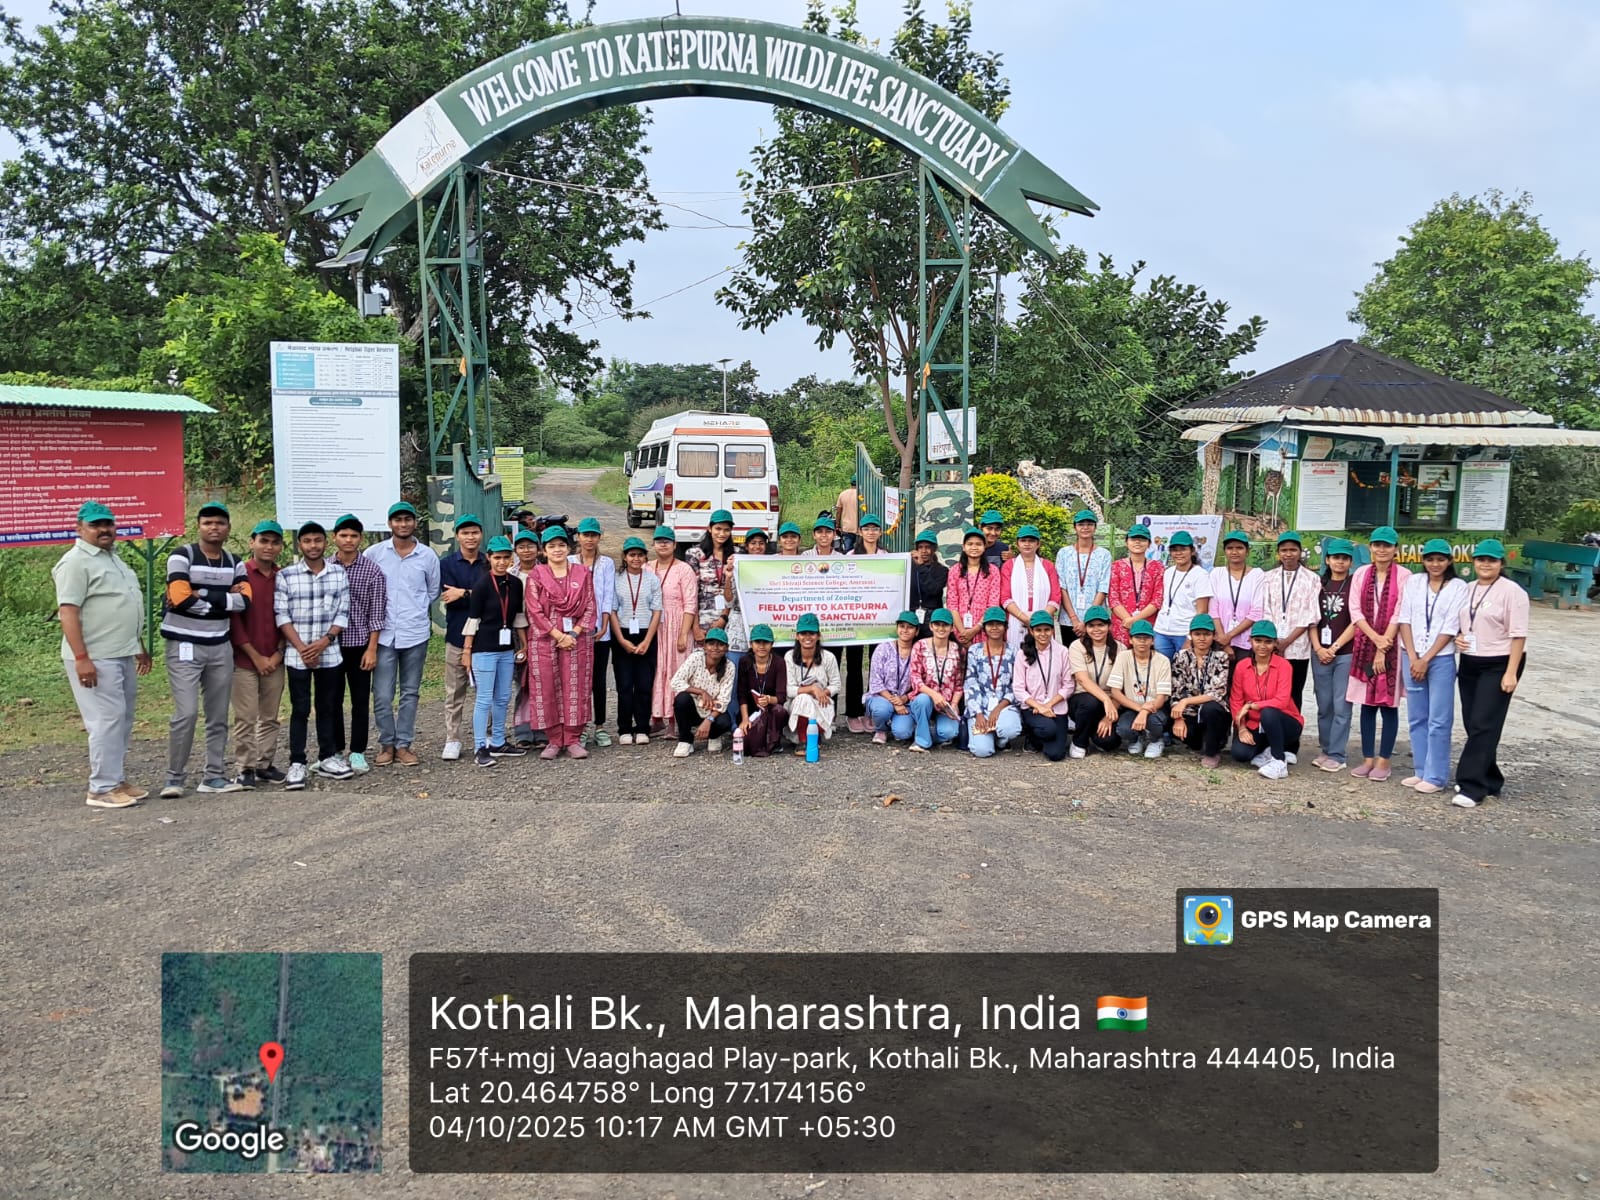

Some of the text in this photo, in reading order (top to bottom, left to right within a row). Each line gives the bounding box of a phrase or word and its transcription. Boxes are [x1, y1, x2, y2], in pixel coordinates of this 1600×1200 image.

[459, 29, 1009, 183] WELCOME TO KATEPURNA WILDLIFE SANCTUARY
[782, 593, 863, 603] Department of Zoology
[758, 602, 888, 612] FIELD VISIT TO KATEPURNA
[820, 612, 878, 621] SANCTUARY
